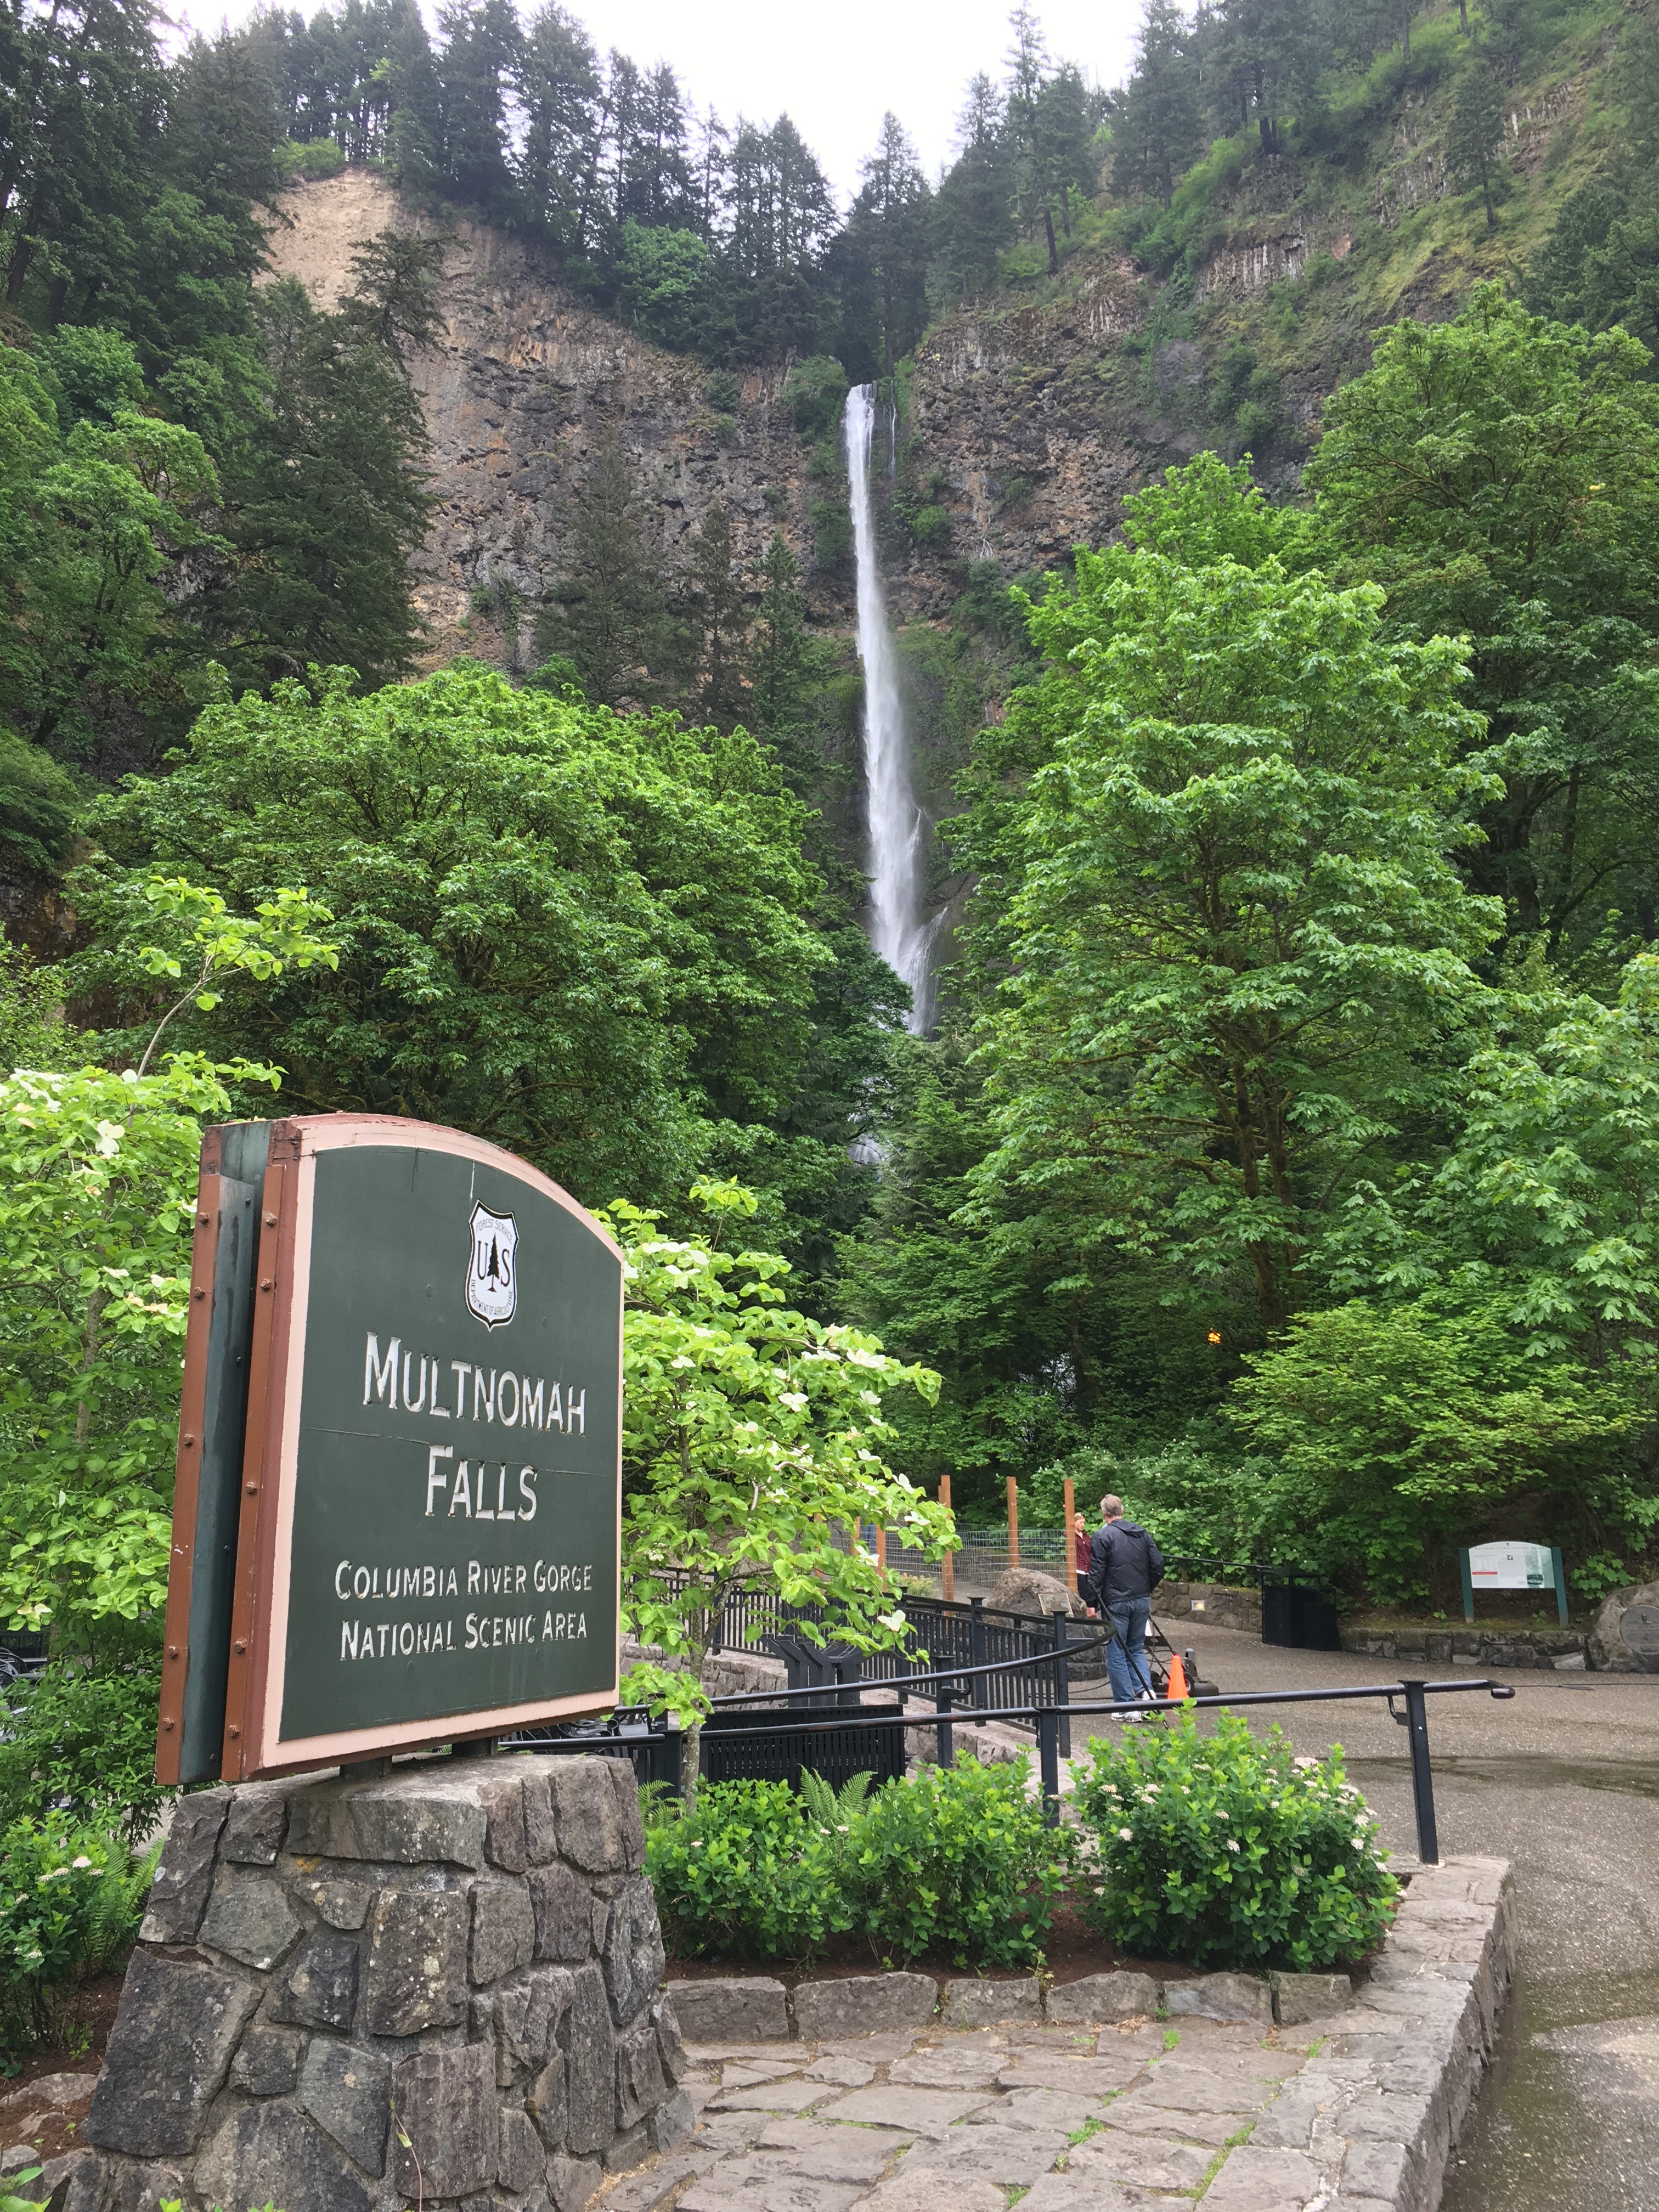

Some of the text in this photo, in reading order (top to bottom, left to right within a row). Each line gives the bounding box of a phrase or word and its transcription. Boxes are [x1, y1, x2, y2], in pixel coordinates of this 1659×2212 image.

[476, 1218, 513, 1245] FOREST SERVICE
[362, 1331, 586, 1437] MULTNOMAH
[425, 1444, 538, 1521] FALLS
[335, 1559, 592, 1600] COLUMBIA RIVER GORGE
[340, 1609, 588, 1661] NATIONAL SCENIC AREA
